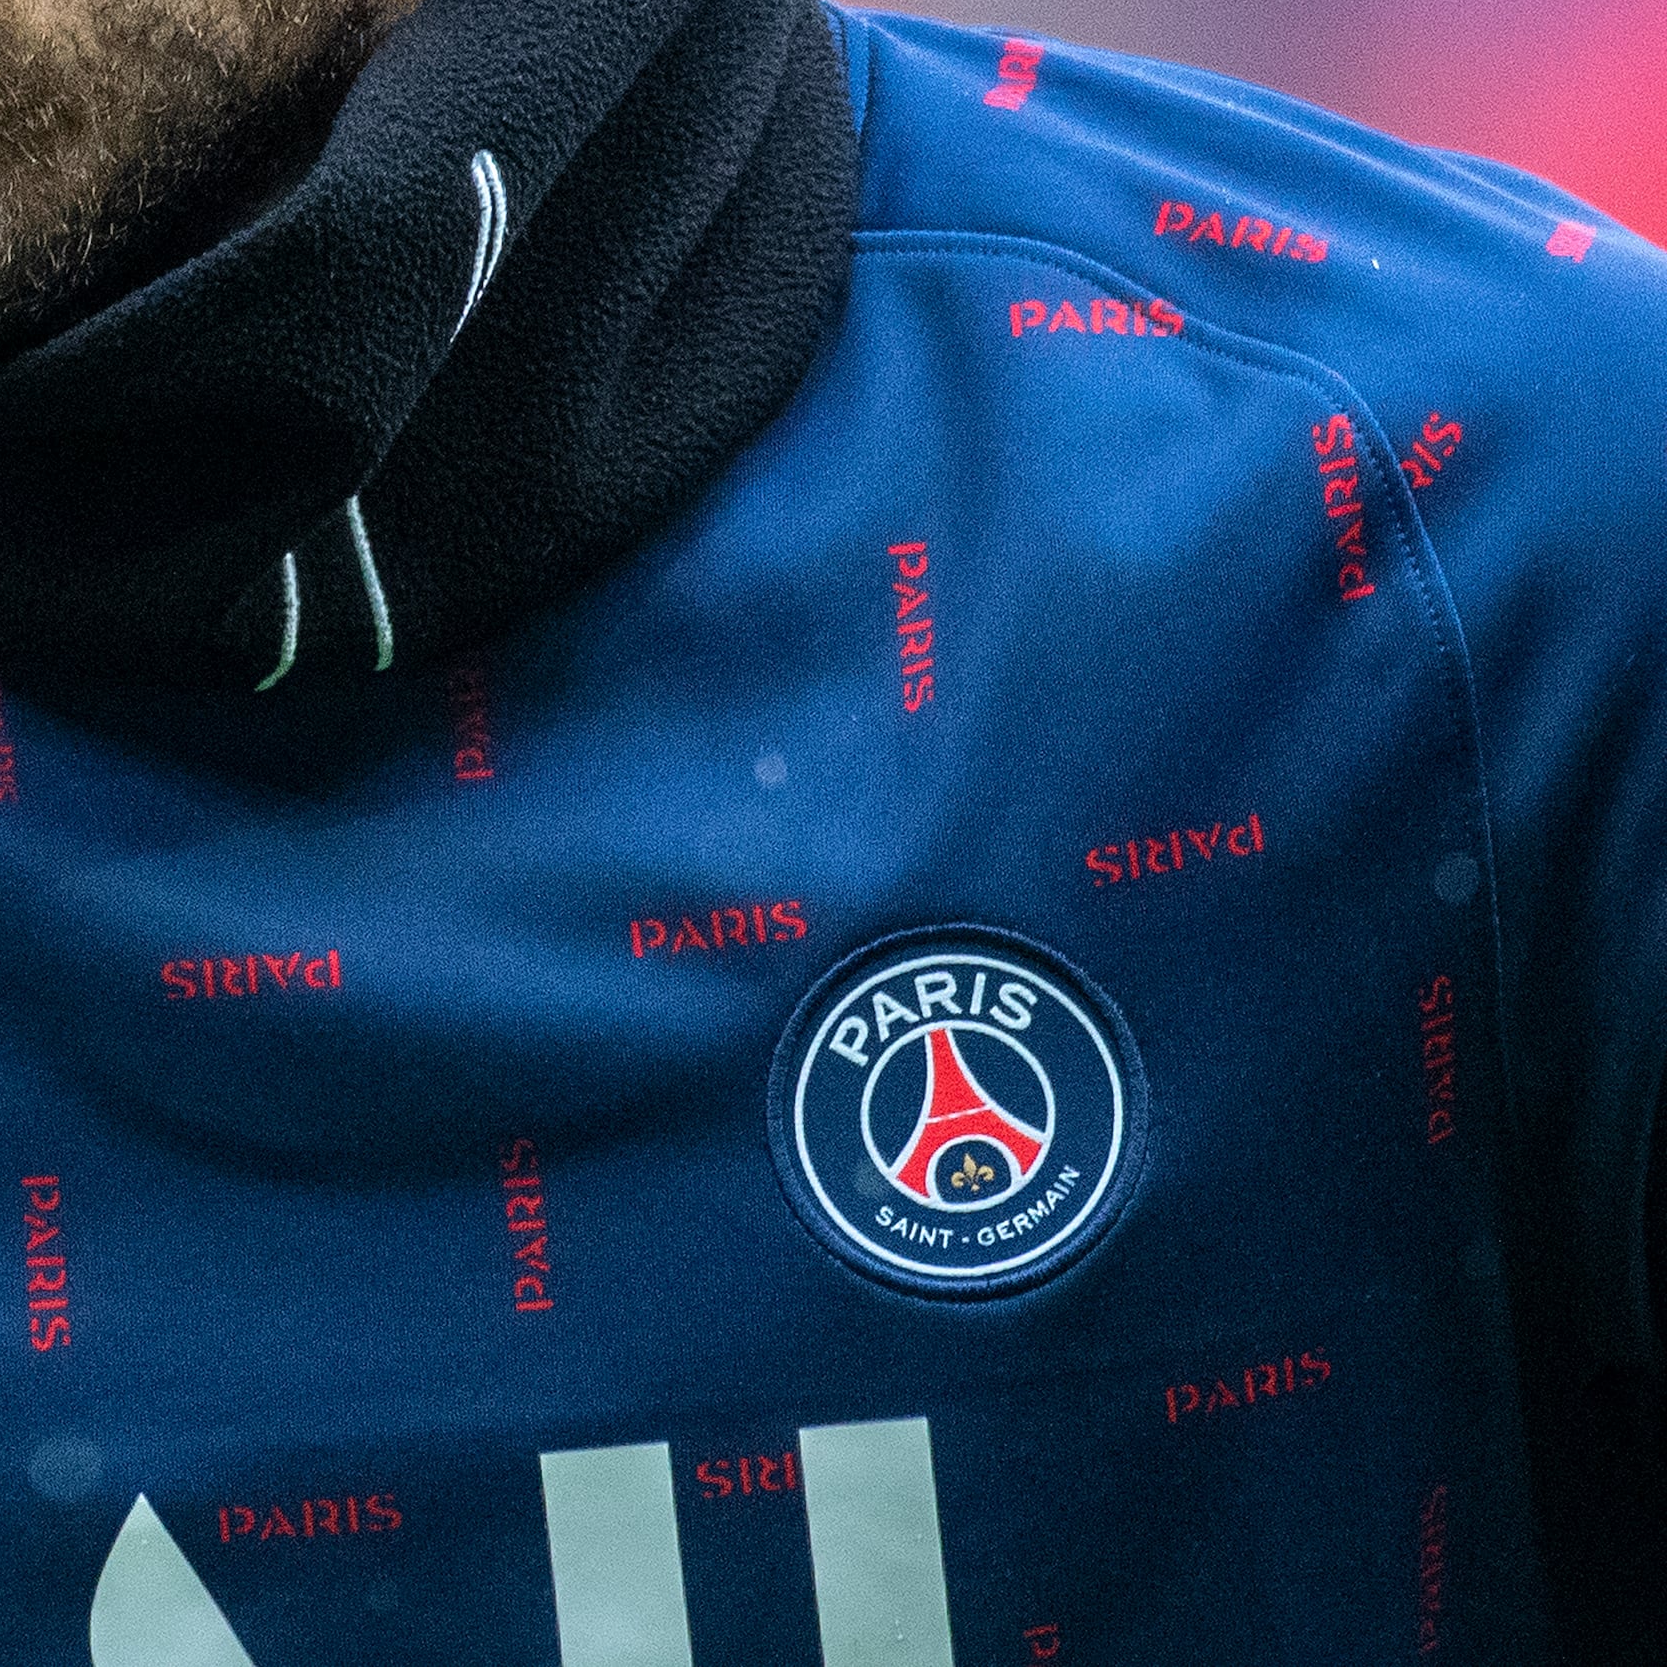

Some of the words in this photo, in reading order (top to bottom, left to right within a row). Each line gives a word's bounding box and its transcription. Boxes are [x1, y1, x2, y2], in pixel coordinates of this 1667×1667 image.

[1154, 201, 1328, 262] PARIS
[1010, 299, 1183, 337] PARIS
[1313, 415, 1375, 599] PARIS
[888, 542, 933, 712] PARIS
[1085, 812, 1264, 885] PARIS
[631, 901, 807, 958] PARIS
[162, 950, 341, 996] PARIS
[829, 971, 1038, 1067] PARIS
[1419, 975, 1454, 1144] PARIS
[498, 1136, 554, 1312] PARIS
[874, 1205, 953, 1248] SAINT
[977, 1165, 1080, 1247] GERMAIN
[23, 1176, 70, 1351] PARIS
[1166, 1347, 1331, 1422] PARIS
[219, 1495, 401, 1542] PARIS
